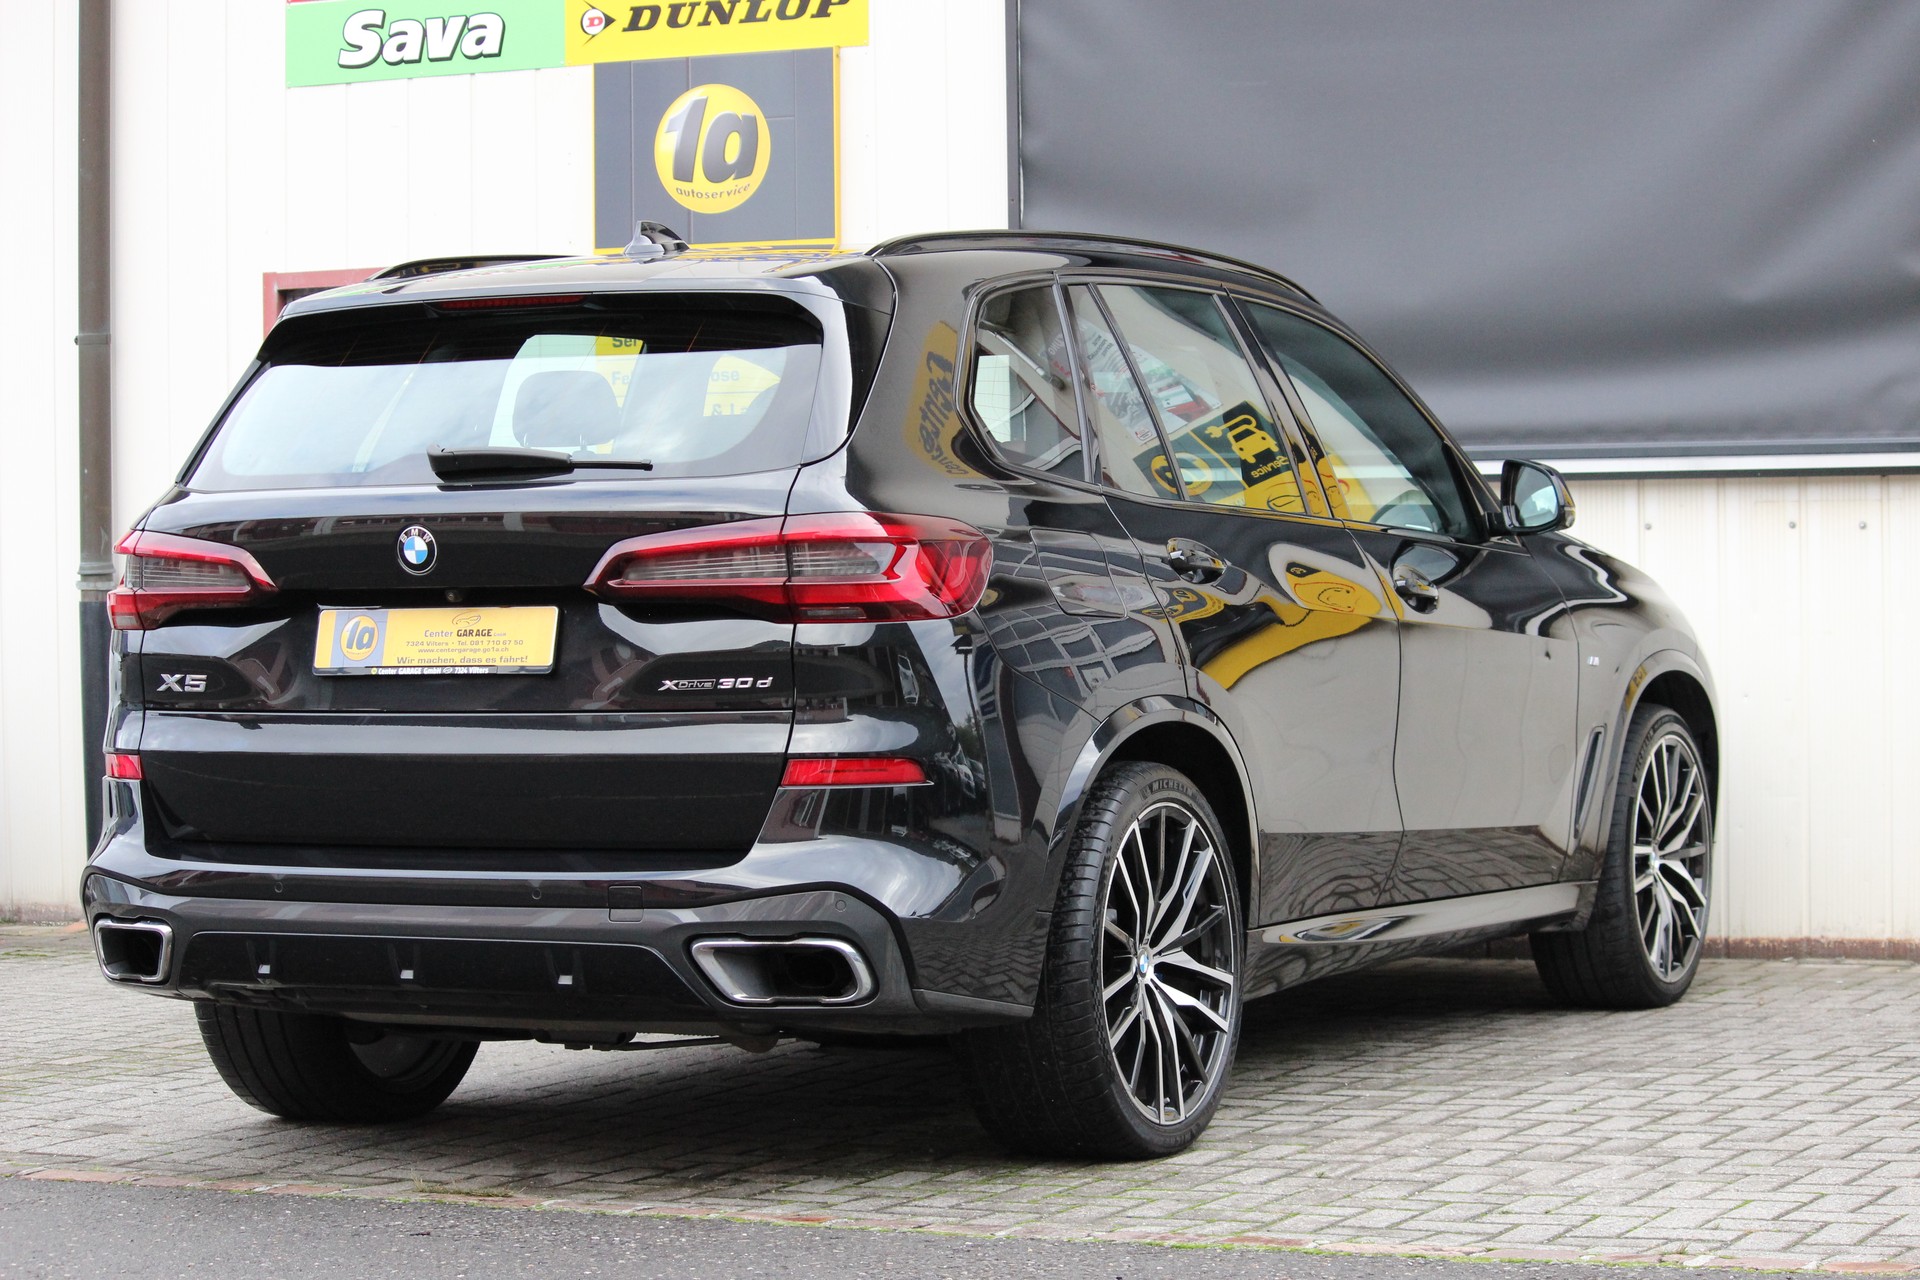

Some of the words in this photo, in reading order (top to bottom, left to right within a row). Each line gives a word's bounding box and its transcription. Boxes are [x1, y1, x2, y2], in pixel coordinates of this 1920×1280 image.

[621, 0, 851, 32] DUNLOP
[338, 9, 506, 69] Sava
[665, 96, 758, 183] 1a
[675, 183, 750, 199] autoservice
[424, 629, 454, 638] Center
[456, 628, 493, 637] GARAGE
[418, 656, 457, 665] machen,
[460, 656, 484, 664] dass
[378, 667, 397, 675] Center
[398, 667, 421, 675] GARAGE
[156, 673, 208, 692] X5
